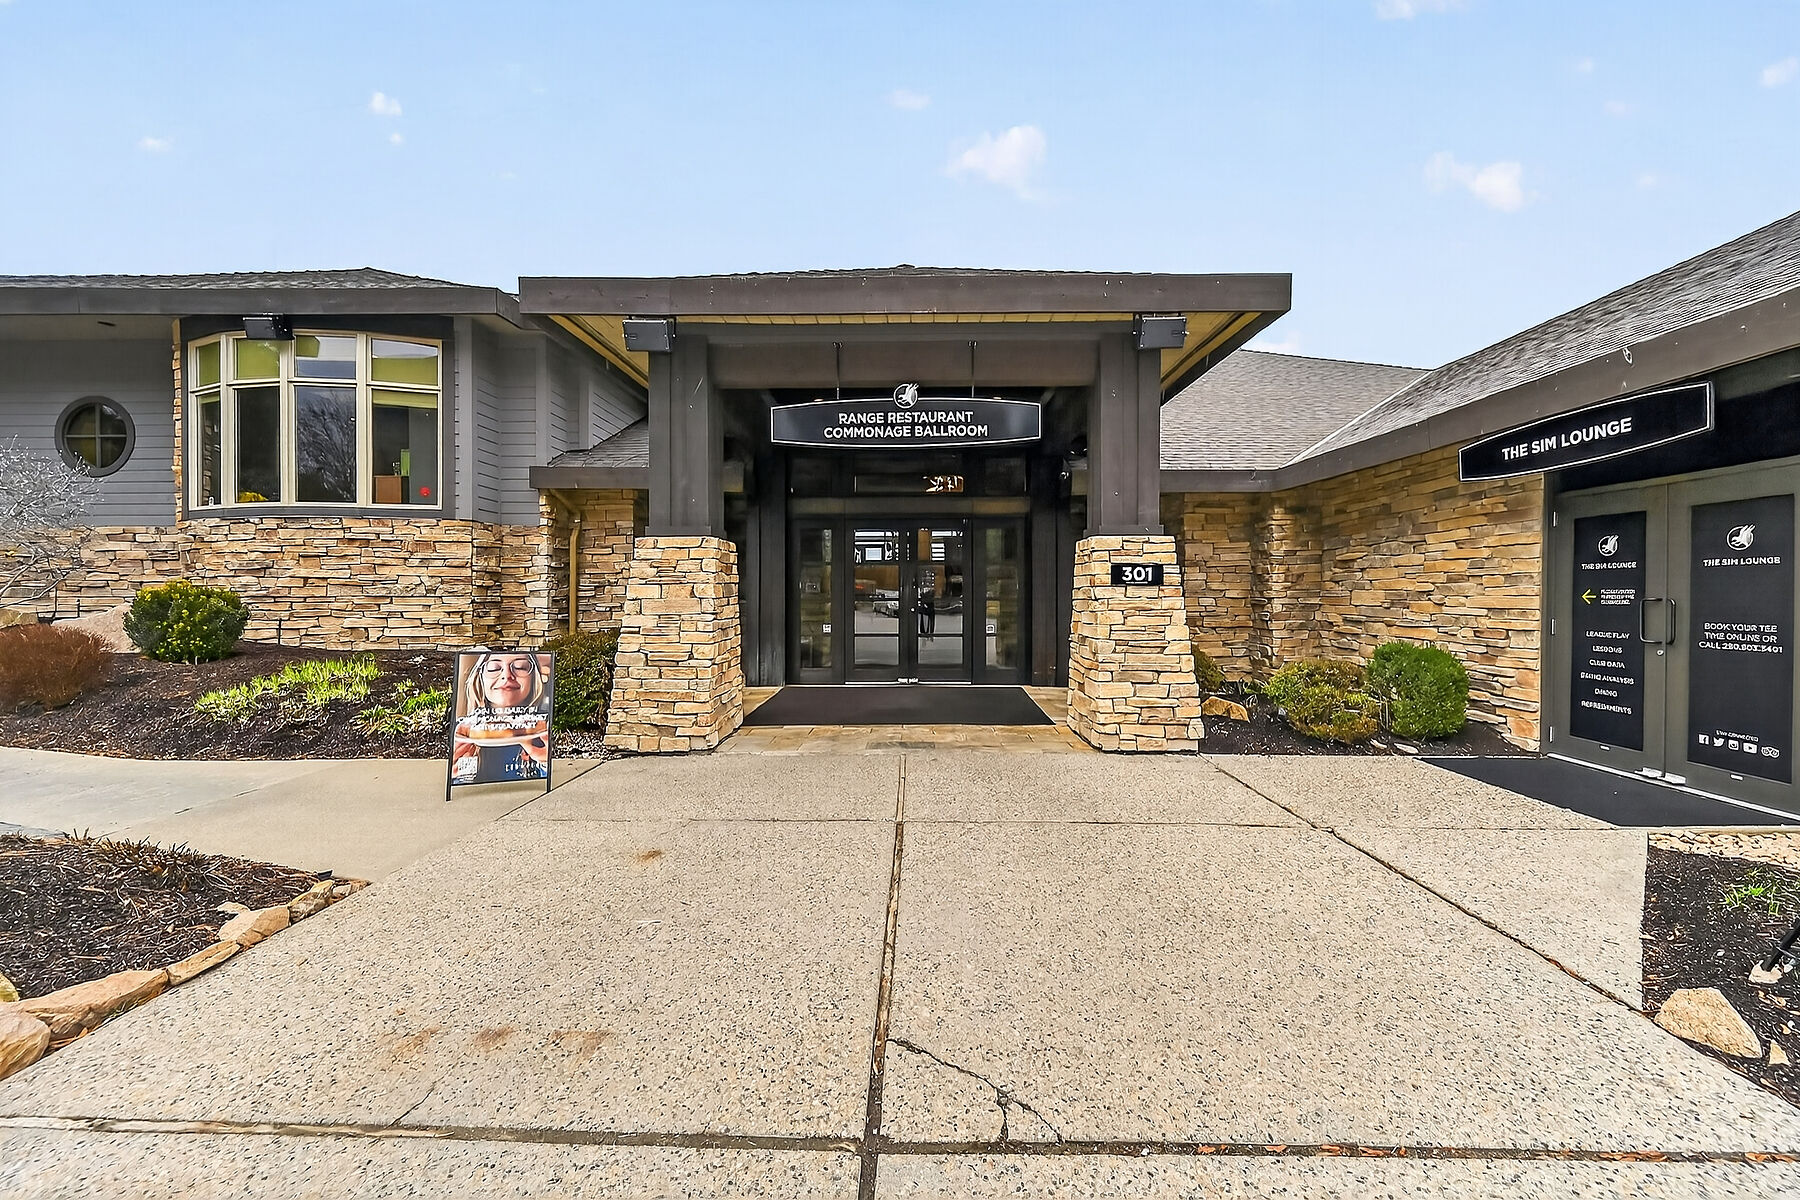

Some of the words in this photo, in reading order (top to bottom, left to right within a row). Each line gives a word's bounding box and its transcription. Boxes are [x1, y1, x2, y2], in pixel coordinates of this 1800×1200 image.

[838, 412, 885, 425] RANGE
[887, 411, 973, 424] RESTAURANT
[823, 425, 911, 439] COMMONAGE
[914, 424, 988, 437] BALLROOM
[1502, 443, 1528, 461] THE
[1531, 436, 1557, 454] SIM
[1560, 417, 1633, 448] LOUNGE
[1702, 558, 1720, 567] THE
[1740, 556, 1781, 565] LOUNGE
[1121, 566, 1153, 582] 301
[1704, 622, 1731, 631] BOOK
[1731, 623, 1757, 631] YOUR
[1758, 625, 1778, 633] TEE
[1698, 641, 1721, 649] CALL
[1762, 635, 1778, 643] OR
